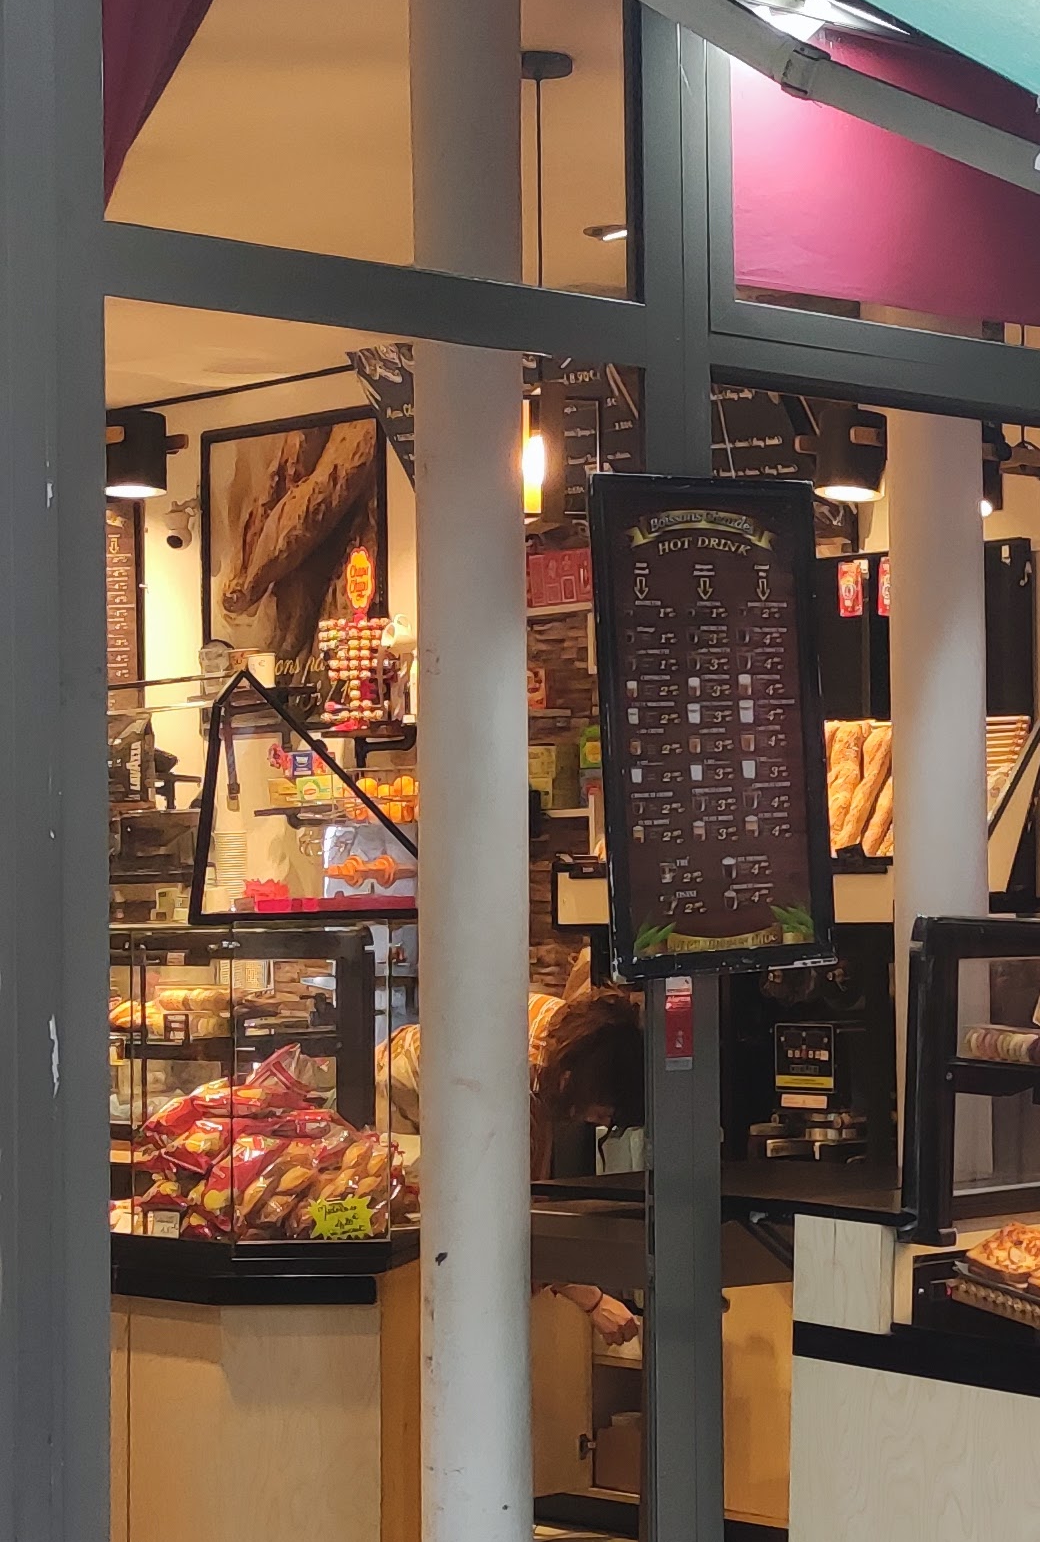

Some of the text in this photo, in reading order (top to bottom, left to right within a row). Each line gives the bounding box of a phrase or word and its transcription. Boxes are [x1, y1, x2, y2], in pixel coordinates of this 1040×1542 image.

[650, 512, 701, 532] Boissons
[658, 536, 752, 556] HOT DRINK
